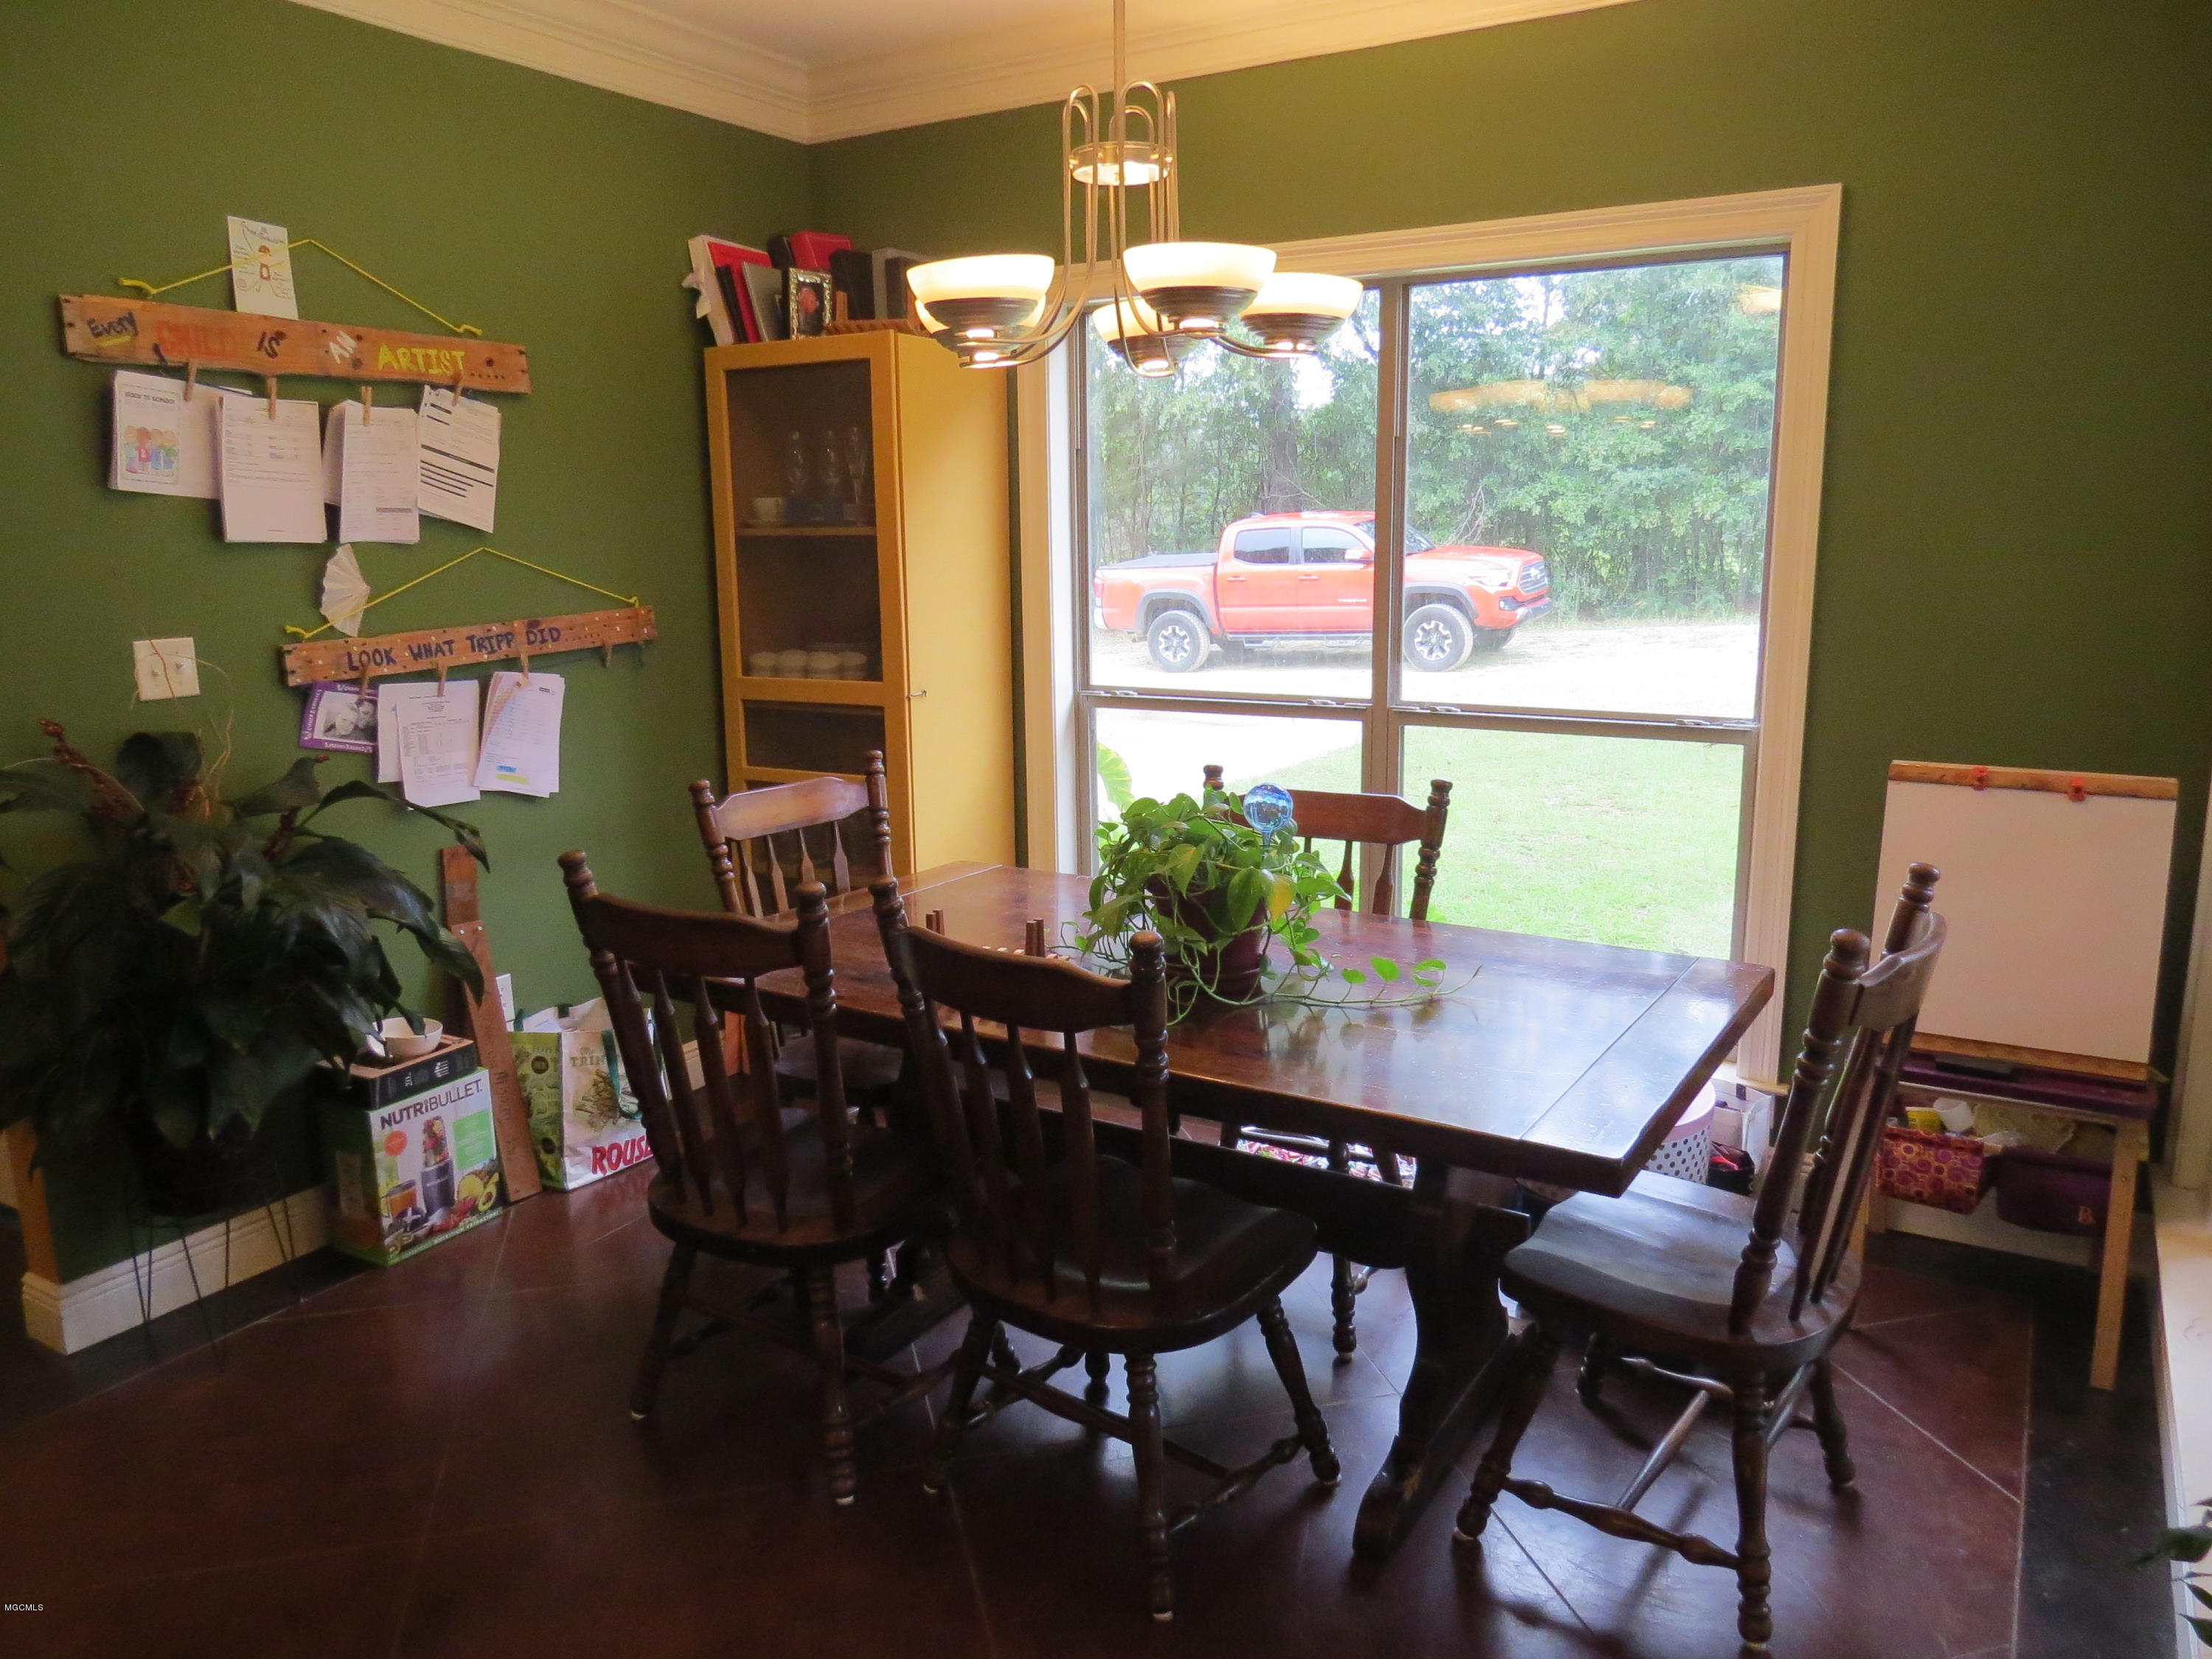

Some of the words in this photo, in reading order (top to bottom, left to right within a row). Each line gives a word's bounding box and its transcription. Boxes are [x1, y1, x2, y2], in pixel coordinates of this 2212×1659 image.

[156, 319, 239, 358] CHILD
[330, 330, 358, 364] AN
[378, 342, 465, 376] ARTIST
[347, 647, 397, 672] LOOK
[408, 639, 454, 661] WHAT
[466, 631, 515, 655] TRIPP
[526, 626, 562, 646] DID
